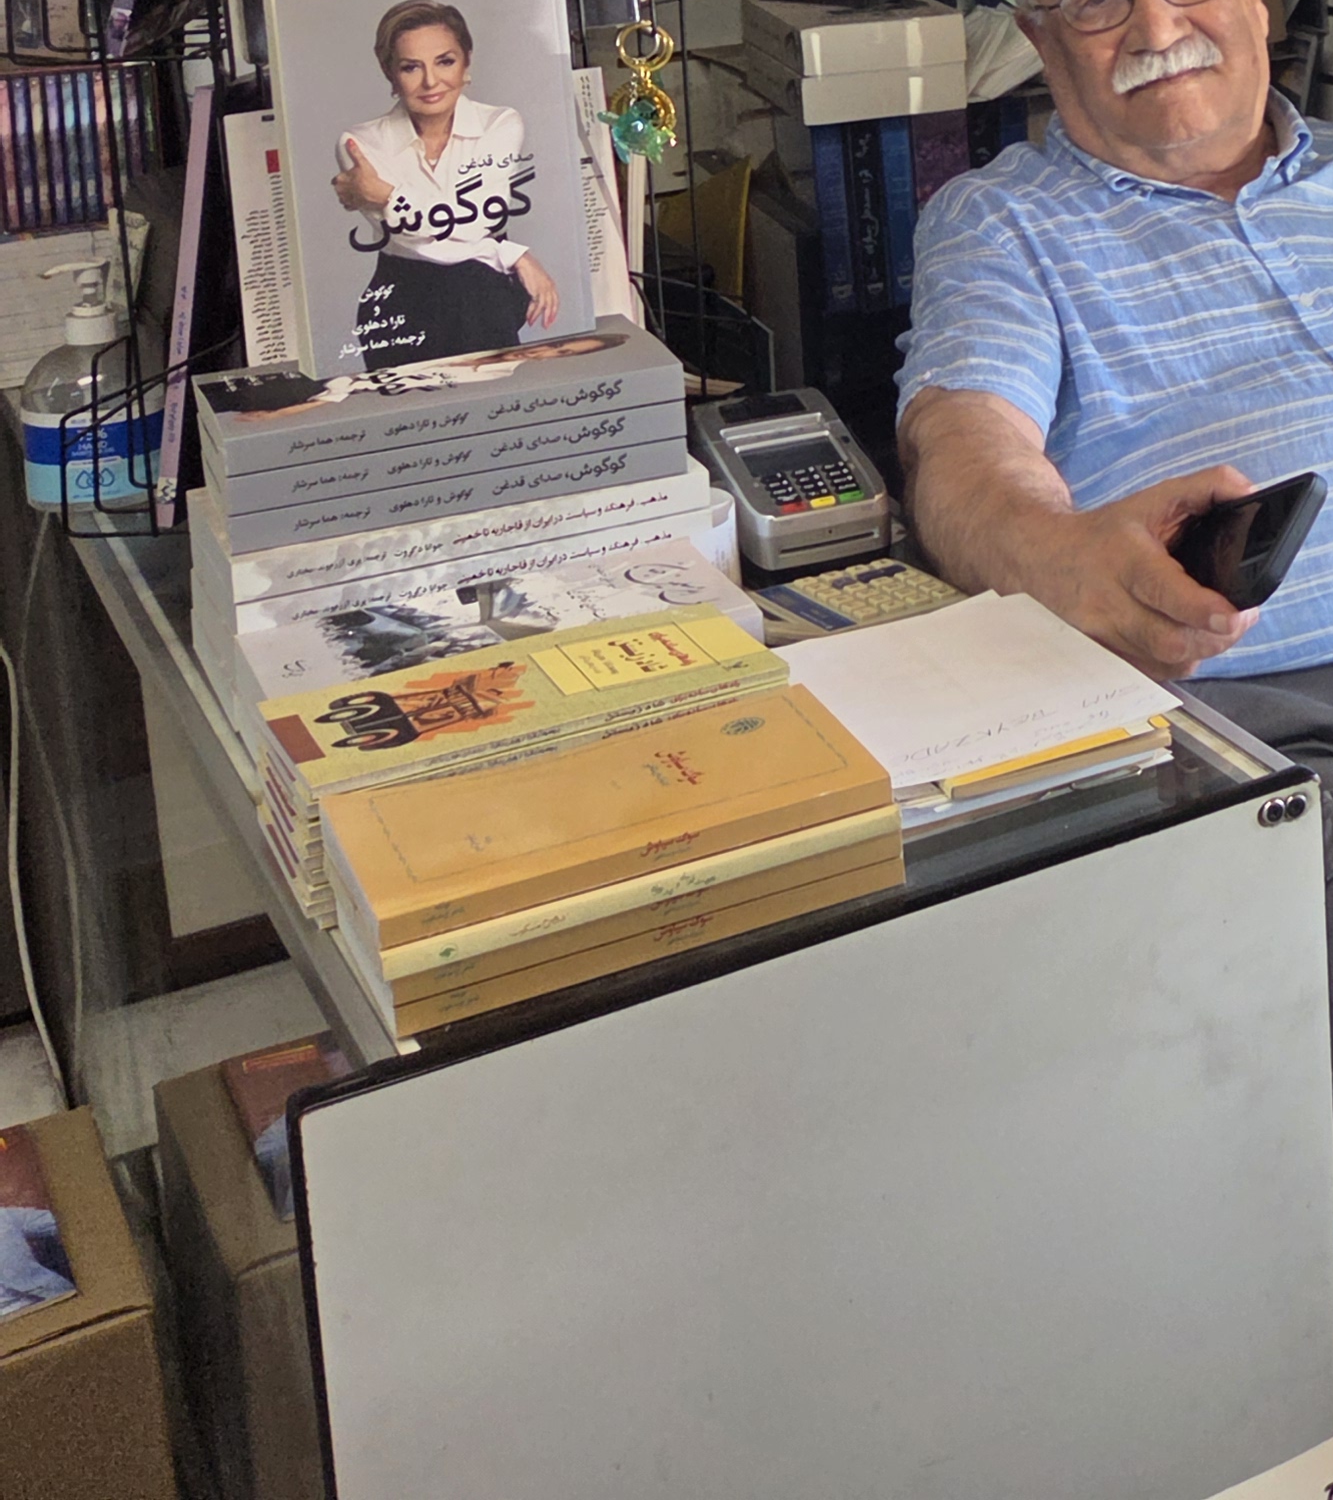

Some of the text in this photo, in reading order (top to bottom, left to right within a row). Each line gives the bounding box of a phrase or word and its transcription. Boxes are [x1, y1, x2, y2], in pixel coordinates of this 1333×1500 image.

[457, 152, 534, 175] صدای قدغن
[348, 166, 536, 252] گوگوش
[373, 305, 381, 317] و
[351, 314, 406, 336] تارا دهلوی
[338, 329, 426, 359] ترجمه: هما سرشار
[487, 400, 521, 420] قدغن
[523, 396, 559, 413] صدای
[490, 437, 524, 458] قدغن
[526, 434, 562, 451] صدای
[492, 475, 525, 496] قدغن
[527, 471, 563, 488] صدای
